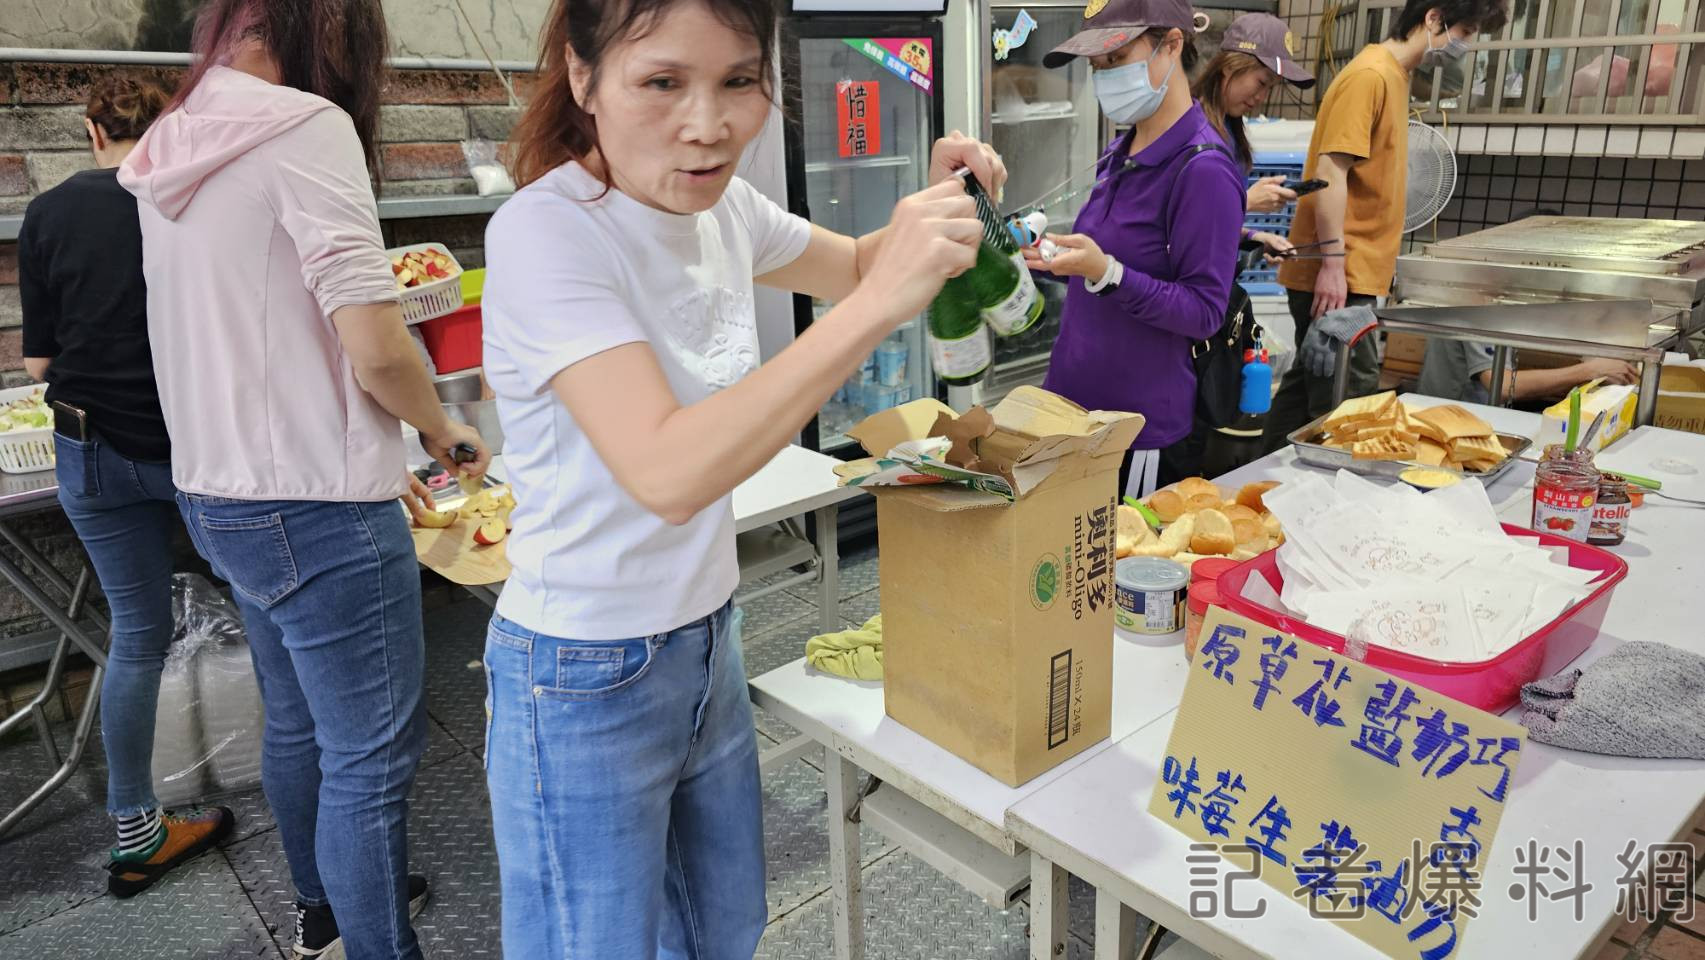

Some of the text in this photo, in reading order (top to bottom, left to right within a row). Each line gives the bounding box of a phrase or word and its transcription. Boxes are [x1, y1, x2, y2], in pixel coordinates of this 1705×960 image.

[847, 84, 867, 156] 惜福
[1071, 514, 1085, 620] mini-Oligo
[1086, 505, 1109, 613] 奧利多
